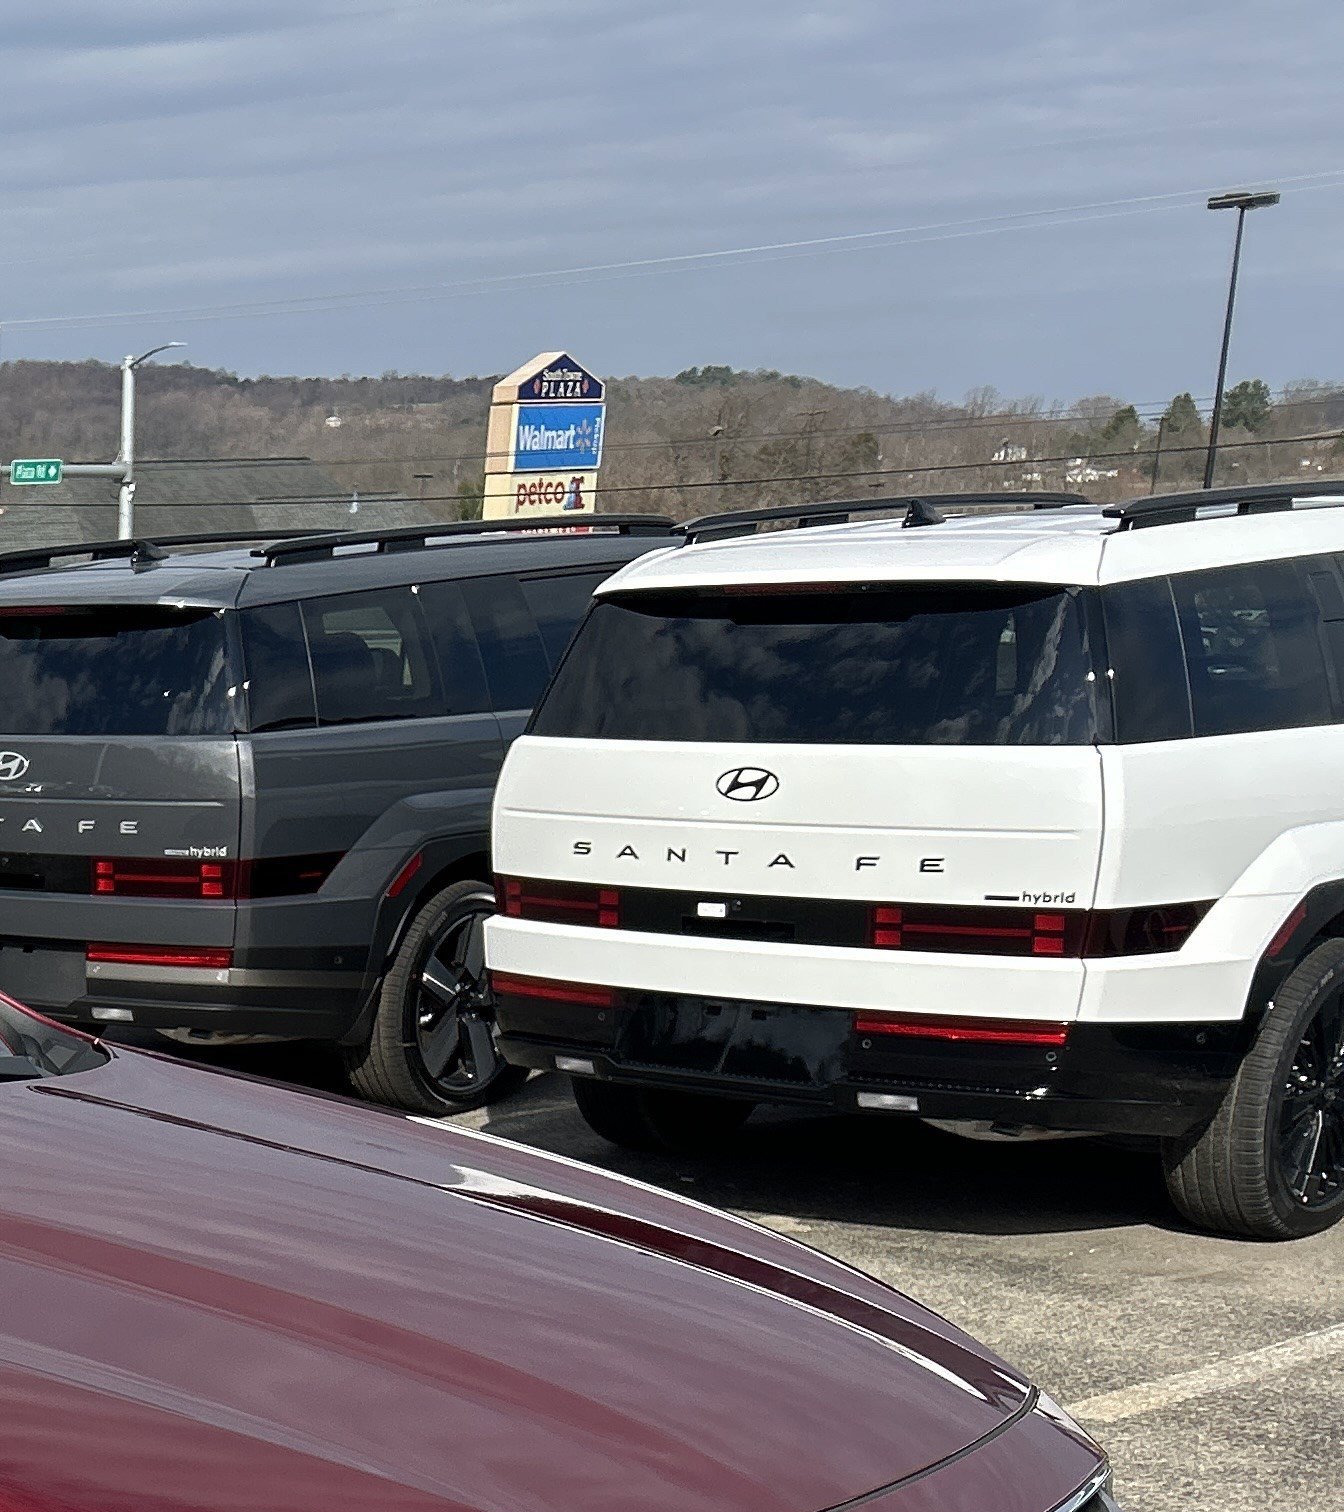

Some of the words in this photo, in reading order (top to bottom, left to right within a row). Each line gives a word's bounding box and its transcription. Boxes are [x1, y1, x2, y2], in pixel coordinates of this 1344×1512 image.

[540, 381, 581, 398] PLAZA
[518, 423, 576, 451] Walmart
[515, 477, 566, 514] petco
[77, 819, 139, 835] FE
[189, 845, 228, 857] hybrid
[573, 841, 796, 869] SANTA
[855, 856, 947, 873] FE
[1021, 890, 1076, 905] hybrid
